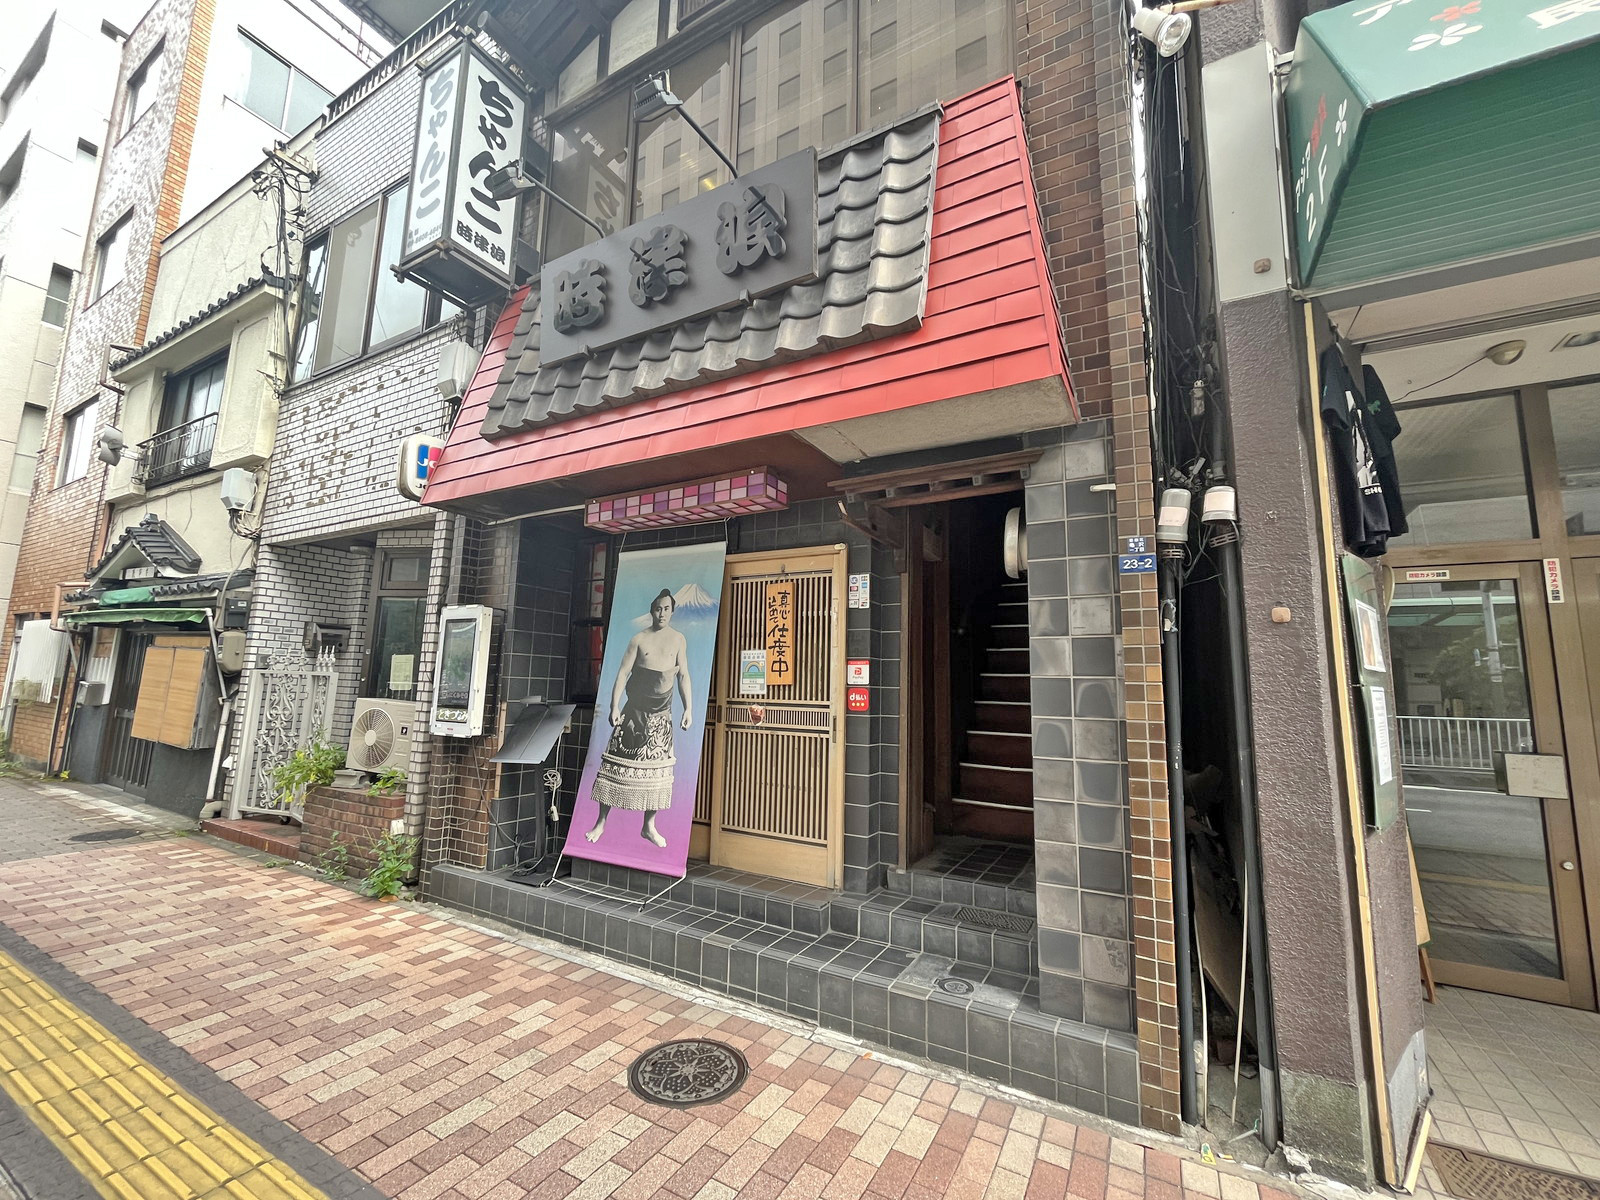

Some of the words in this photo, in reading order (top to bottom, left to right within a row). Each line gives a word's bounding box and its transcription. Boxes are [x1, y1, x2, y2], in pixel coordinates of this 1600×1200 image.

[416, 67, 454, 219] ちゃんこ
[465, 75, 514, 235] ちゃんこ
[1123, 558, 1153, 570] 23-2
[768, 595, 779, 623] 込めて
[777, 589, 791, 620] 真心
[767, 623, 791, 678] 仕度中
[849, 692, 867, 701] d払い
